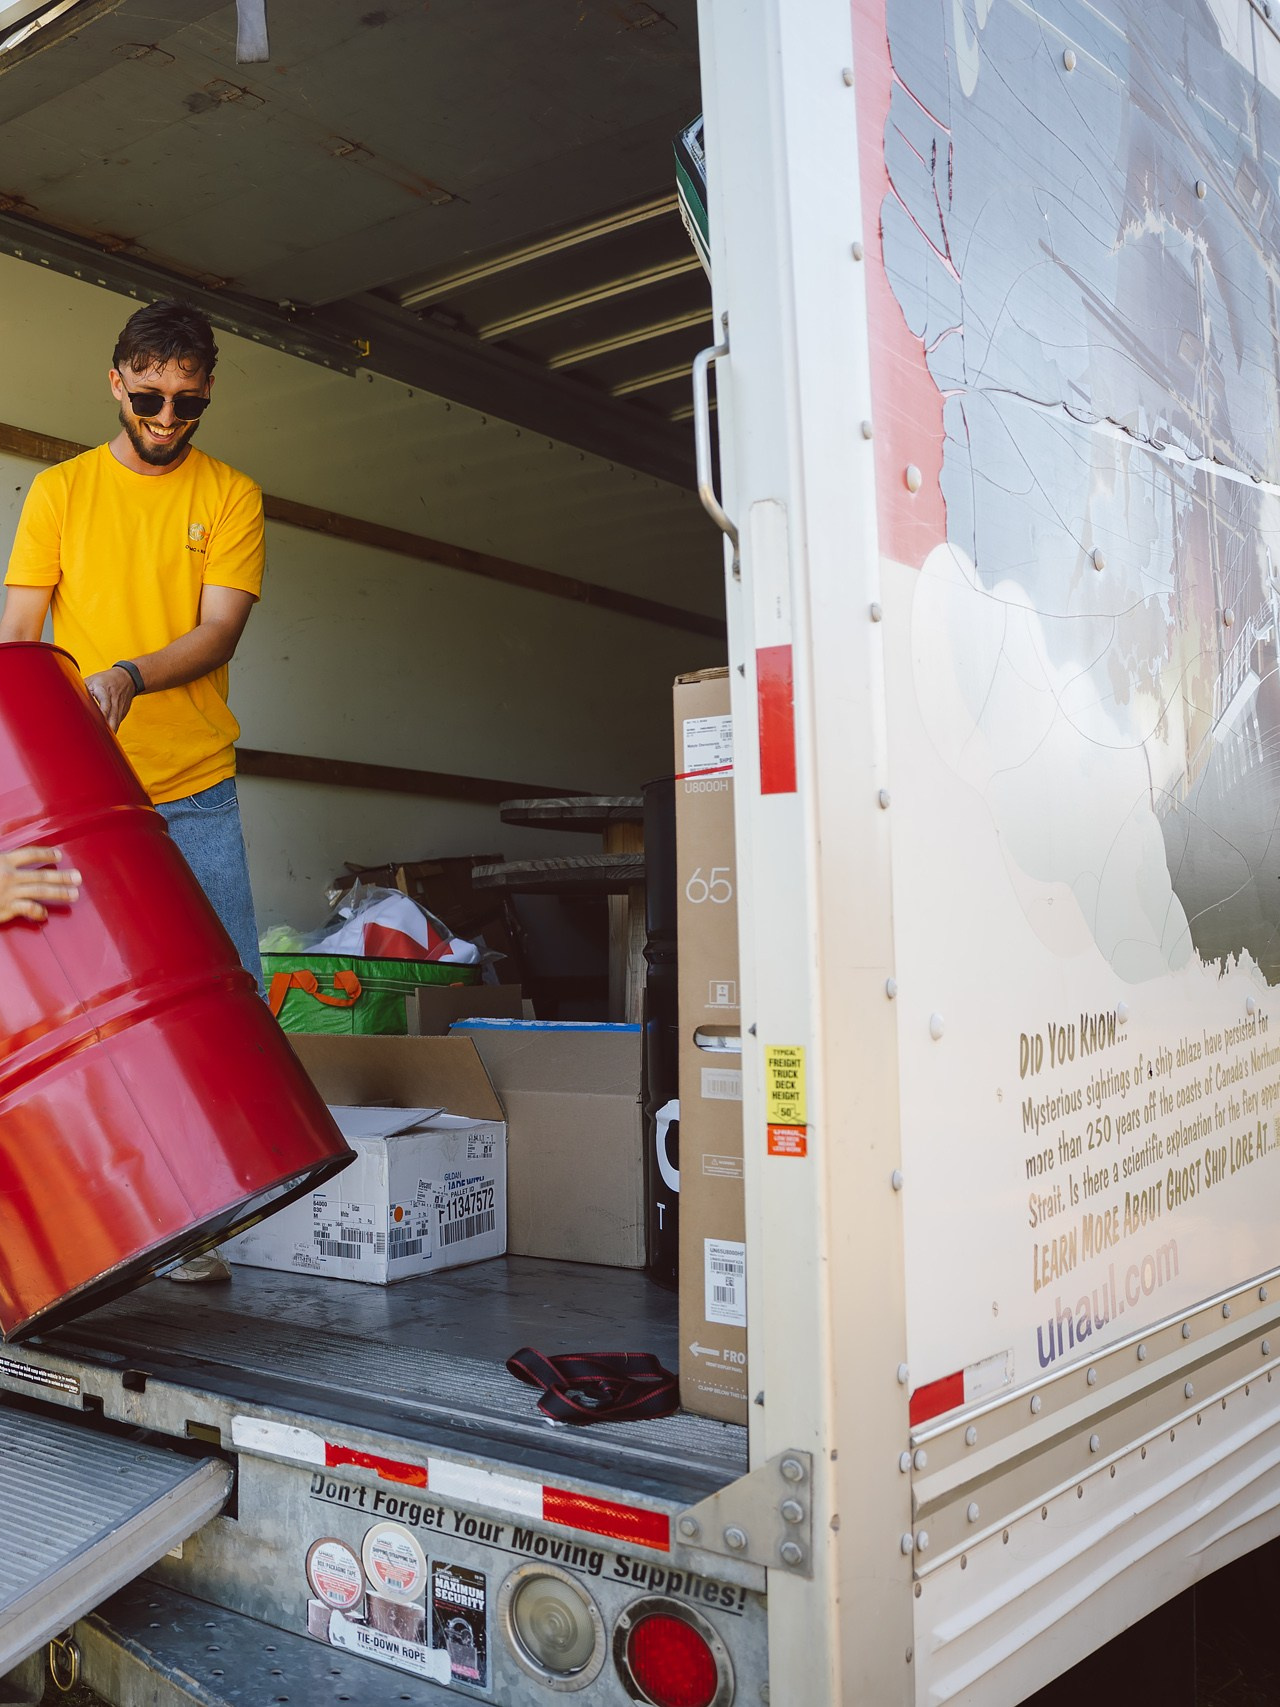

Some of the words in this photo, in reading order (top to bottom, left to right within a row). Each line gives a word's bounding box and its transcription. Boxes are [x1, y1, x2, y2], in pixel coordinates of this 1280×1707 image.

[685, 780, 728, 793] U8000H
[685, 867, 732, 904] 65
[769, 1058, 801, 1068] FREIGHT
[1020, 1033, 1043, 1080] DID
[773, 1069, 798, 1078] TRUCK
[1022, 1088, 1082, 1136] Mysterious
[1086, 1067, 1130, 1109] sightings
[1134, 1053, 1143, 1086] of
[1147, 1060, 1153, 1080] a
[1156, 1045, 1173, 1078] ship
[1176, 1037, 1201, 1068] ablaze
[1204, 1028, 1222, 1057] have
[1224, 1013, 1255, 1055] persisted
[1258, 1008, 1268, 1034] for
[776, 1080, 796, 1089] DECK
[772, 1091, 800, 1101] HEIGHT
[1026, 1148, 1054, 1180] more
[1058, 1130, 1082, 1165] than
[1086, 1115, 1112, 1150] 250
[1116, 1109, 1141, 1144] years
[1144, 1090, 1156, 1124] off
[1160, 1086, 1174, 1116] the
[1177, 1077, 1202, 1108] coasts
[1205, 1065, 1212, 1095] of
[1216, 1055, 1248, 1091] Canada's
[1029, 1184, 1066, 1228] Strait.
[1069, 1174, 1080, 1206] Is
[1083, 1165, 1109, 1199] there
[1113, 1162, 1119, 1183] a
[1123, 1132, 1163, 1178] scientific
[1166, 1112, 1212, 1157] explanation
[1215, 1102, 1226, 1130] for
[1228, 1094, 1240, 1123] the
[1242, 1088, 1258, 1116] fiery
[444, 1172, 462, 1180] GILDAN
[451, 1188, 468, 1198] PALLET
[1034, 1226, 1077, 1294] LEARN
[1082, 1205, 1120, 1262] MORE
[1123, 1179, 1162, 1238] ABOUT
[1166, 1158, 1201, 1212] GHOST
[1205, 1145, 1227, 1189] SHIP
[1230, 1131, 1254, 1176] LORE
[1036, 1238, 1179, 1368] uhaul.com
[724, 1350, 746, 1364] FRO
[310, 1473, 367, 1507] Don't
[373, 1490, 445, 1527] Forget
[453, 1510, 504, 1543] Your
[511, 1527, 604, 1577] Moving
[613, 1554, 748, 1610] Supplies!
[435, 1578, 484, 1600] MAXIMUM
[435, 1588, 484, 1610] SECURITY
[357, 1631, 399, 1654] TIE-DOWN
[402, 1647, 426, 1663] ROPE
